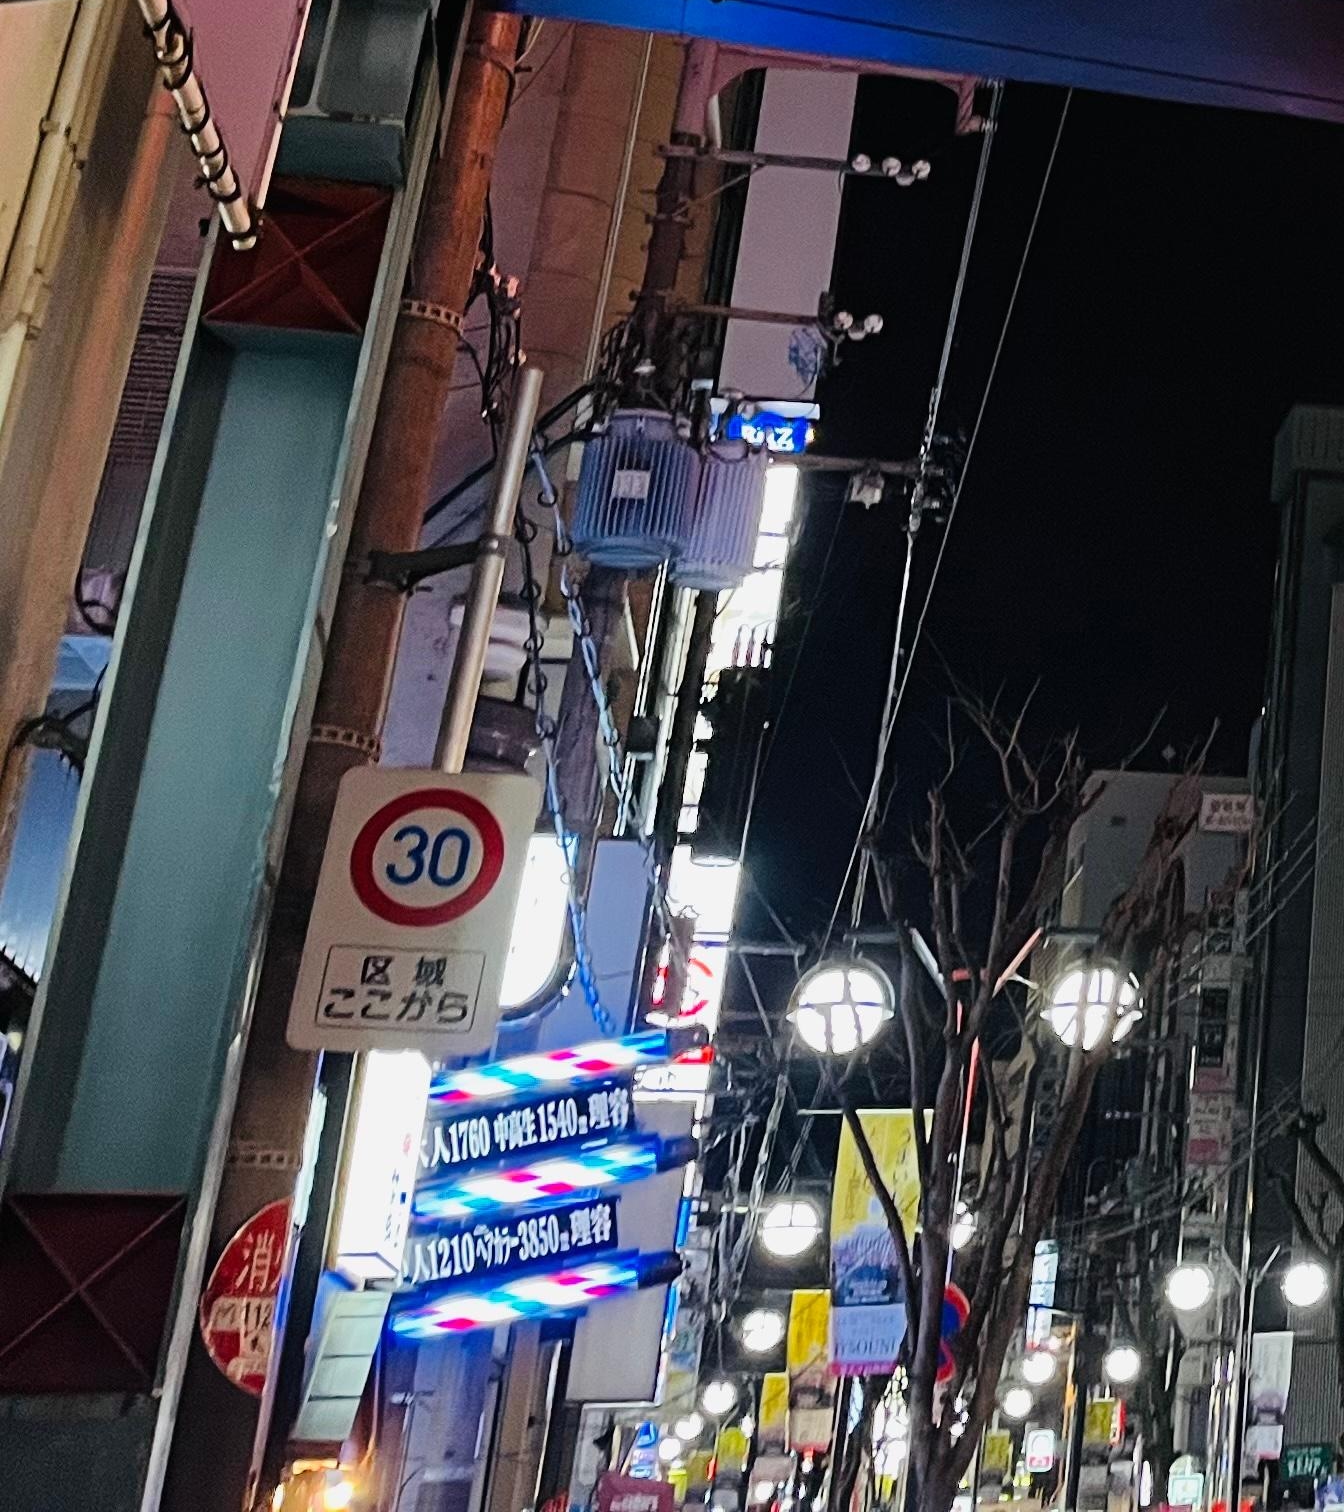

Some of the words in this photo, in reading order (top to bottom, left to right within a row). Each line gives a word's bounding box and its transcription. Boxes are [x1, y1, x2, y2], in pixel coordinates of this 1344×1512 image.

[386, 824, 472, 888] 30
[323, 988, 469, 1024] ここから
